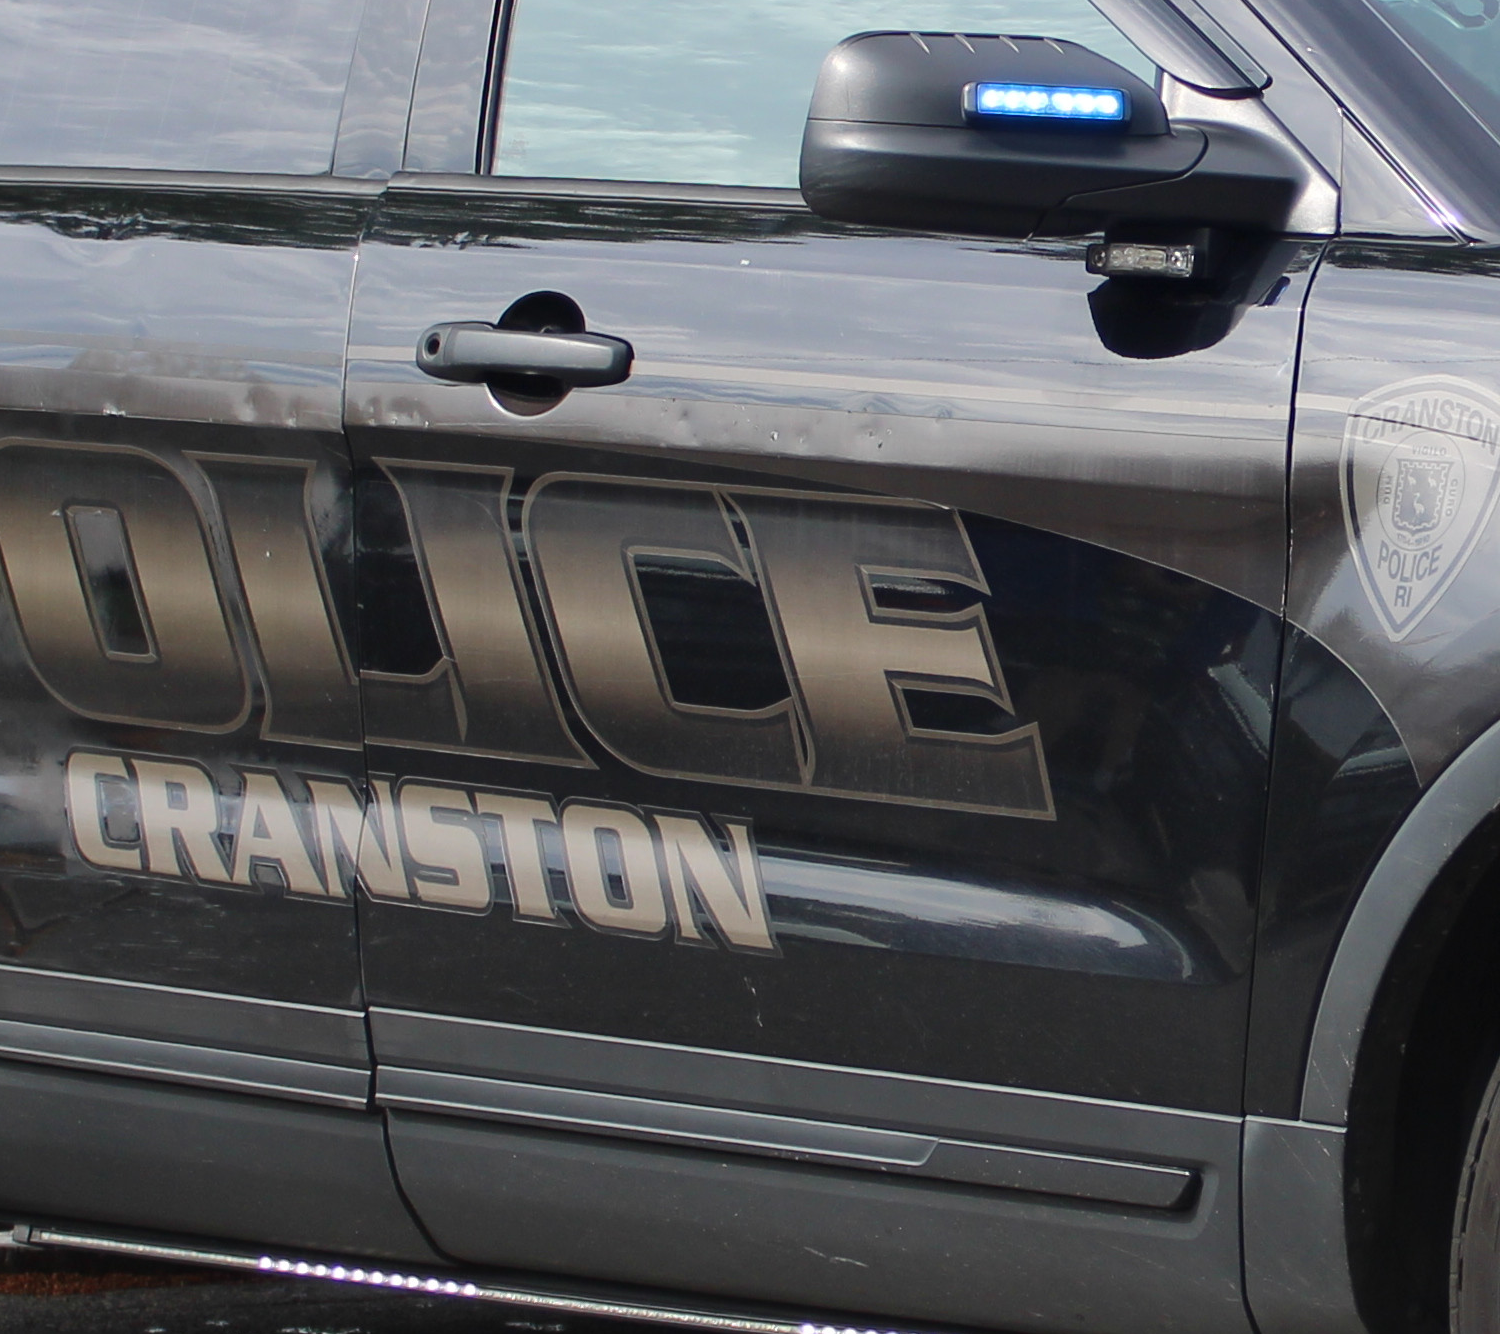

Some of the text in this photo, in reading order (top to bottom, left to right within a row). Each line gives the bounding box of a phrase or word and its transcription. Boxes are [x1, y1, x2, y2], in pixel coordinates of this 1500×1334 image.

[1362, 397, 1500, 456] CRANSTON
[1412, 445, 1447, 457] VIGILO
[1445, 478, 1459, 517] CURO
[1377, 539, 1444, 584] POLICE
[1393, 585, 1412, 608] RI
[64, 747, 780, 955] CRANSTON
